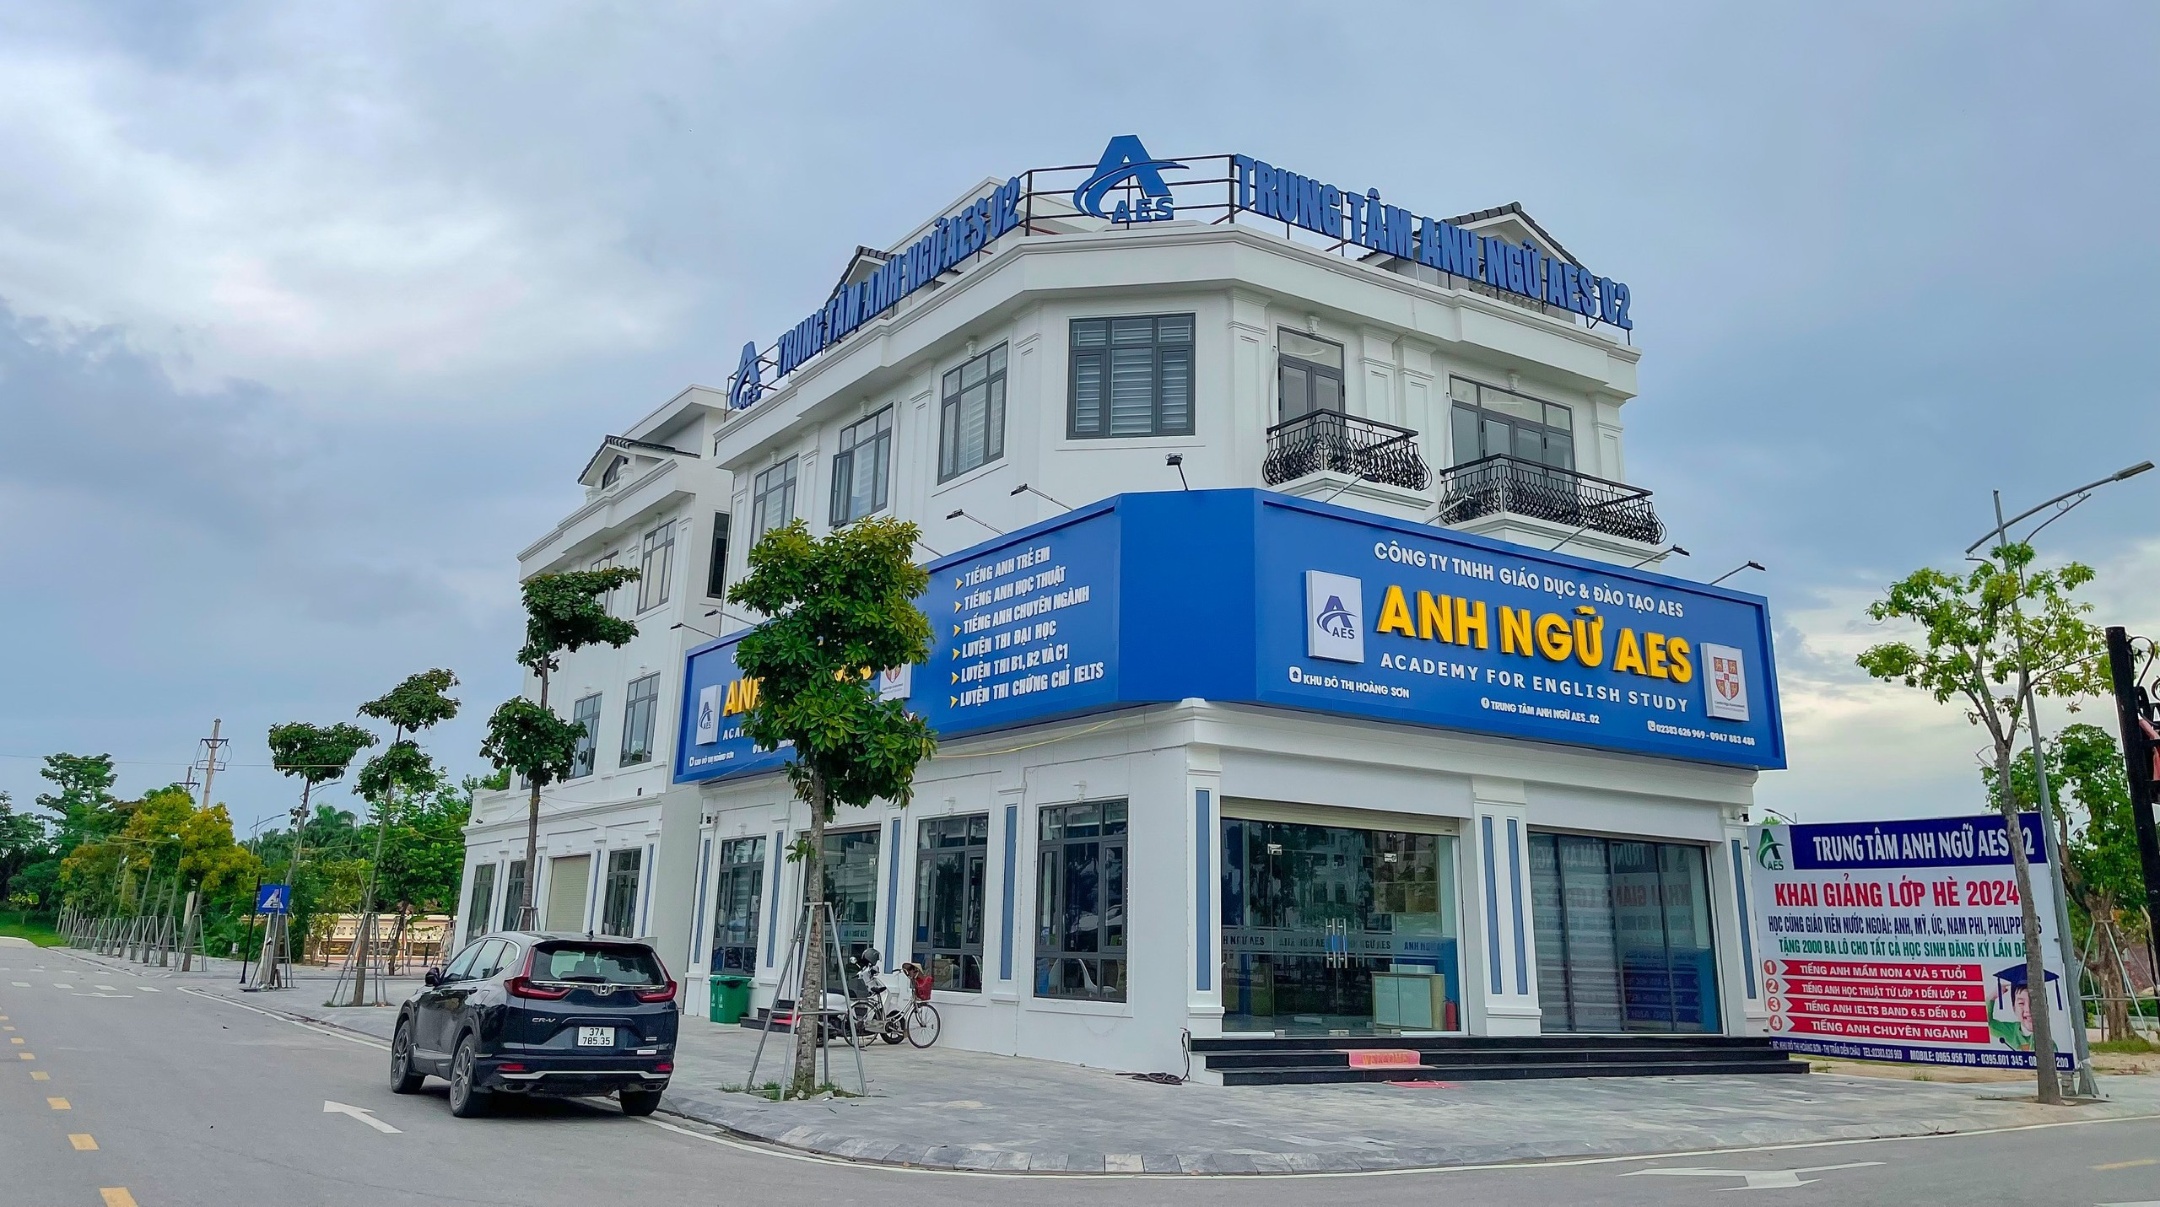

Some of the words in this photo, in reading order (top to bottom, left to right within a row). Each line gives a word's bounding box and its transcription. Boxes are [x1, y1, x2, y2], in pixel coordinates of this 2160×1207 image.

[1111, 198, 1175, 224] AES
[1235, 153, 1340, 239] TRUNG
[1347, 187, 1413, 260] TÂM
[1420, 217, 1480, 281] ANH
[1483, 239, 1543, 300] NGỮ
[1546, 257, 1597, 318] AES
[1600, 277, 1634, 331] 02
[777, 307, 826, 378] TRUNG
[826, 280, 864, 343] TÂM
[863, 253, 902, 320] ANH
[905, 216, 945, 295] NGỮ
[944, 199, 987, 269] AES
[990, 177, 1021, 239] 02
[738, 384, 762, 409] AES
[965, 564, 993, 587] TIẾNG
[995, 558, 1015, 578] ANH
[1017, 547, 1034, 570] TRẺ
[1035, 546, 1051, 564] EM
[1373, 540, 1427, 567] CÔNG
[1429, 555, 1449, 572] TY
[1452, 558, 1495, 582] TNHH
[1499, 564, 1540, 591] GIÁO
[1543, 576, 1576, 601] DỤC
[1579, 584, 1590, 599] &
[1593, 581, 1623, 605] ĐÀO
[1626, 592, 1656, 617] TẠO
[1657, 599, 1684, 618] AES
[964, 588, 992, 611] TIẾNG
[994, 583, 1014, 602] ANH
[1015, 576, 1034, 597] HỌC
[1036, 565, 1066, 590] THUẬT
[964, 611, 991, 634] TIẾNG
[992, 604, 1012, 627] ANH
[1014, 595, 1052, 619] CHUYÊN
[1053, 585, 1090, 610] NGÀNH
[962, 635, 992, 659] LUYỆN
[995, 632, 1011, 650] THI
[1014, 626, 1031, 646] ĐẠI
[1035, 620, 1057, 641] HỌC
[1331, 626, 1355, 640] AES
[1376, 585, 1489, 649] ANH
[1500, 606, 1604, 667] NGỮ
[1613, 627, 1693, 684] AES
[961, 660, 991, 683] LUYỆN
[994, 656, 1010, 676] THI
[1026, 651, 1040, 668] B2
[1042, 643, 1055, 665] VÀ
[1055, 643, 1069, 661] C1
[960, 685, 990, 707] LUYỆN
[993, 682, 1009, 700] THI
[1012, 673, 1048, 696] CHỨNG
[1051, 663, 1070, 688] CHỈ
[1074, 661, 1104, 683] IELTS
[1303, 674, 1322, 686] KHU
[1324, 676, 1338, 688] ĐÔ
[1340, 680, 1355, 693] THỊ
[1356, 681, 1388, 694] HOÀNG
[1391, 686, 1410, 698] SƠN
[1379, 652, 1478, 683] ACADEMY
[1486, 669, 1526, 690] FOR
[1533, 676, 1620, 703] ENGLISH
[1627, 689, 1689, 712] STUDY
[1490, 700, 1516, 713] TRUNG
[1518, 703, 1534, 716] TÂM
[1536, 708, 1552, 717] ANH
[1553, 709, 1570, 720] NGỮ
[1813, 835, 1864, 861] TRUNG
[1865, 826, 1899, 860] TÂM
[1902, 832, 1937, 859] ANH
[1938, 823, 1974, 858] NGỮ
[1978, 828, 2009, 857] AES
[1767, 860, 1784, 870] AES
[1774, 883, 1818, 907] KHAI
[1823, 872, 1883, 907] GIẢNG
[1888, 875, 1926, 907] LỚP
[1932, 876, 1960, 907] HÈ
[1966, 880, 2020, 906] 2024
[1768, 915, 1783, 936] HỌC
[1785, 912, 1804, 933] CÙNG
[1806, 913, 1822, 933] GIÁO
[1824, 913, 1842, 933] VIÊN
[1843, 912, 1864, 934] NƯỚC
[1865, 914, 1893, 934] NGOÀI:
[1894, 917, 1914, 936] ANH,
[1914, 914, 1931, 936] MỸ,
[1931, 913, 1946, 937] ÚC,
[1947, 917, 1967, 935] NAM
[1969, 917, 1986, 936] PHI,
[1778, 937, 1800, 956] TẶNG
[1802, 940, 1823, 954] 2000
[1824, 940, 1837, 954] BA
[1839, 938, 1849, 955] LÔ
[1850, 941, 1868, 955] CHO
[1870, 936, 1885, 956] TẤT
[1888, 935, 1901, 956] CẢ
[1903, 941, 1921, 960] HỌC
[1924, 941, 1946, 957] SINH
[1949, 938, 1975, 957] ĐĂNG
[1978, 938, 1990, 957] KÝ
[1993, 937, 2013, 958] LẦN
[1767, 961, 1773, 974] 1
[1799, 962, 1827, 975] TIẾNG
[1829, 966, 1850, 976] ANH
[1880, 968, 1902, 978] NON
[1904, 969, 1911, 978] 4
[1913, 967, 1930, 978] VÀ
[1931, 970, 1938, 978] 5
[1940, 964, 1967, 979] TUỔI
[1768, 980, 1777, 993] 2
[1801, 981, 1823, 994] TIẾNG
[1824, 985, 1840, 995] ANH
[1841, 987, 1857, 998] HỌC
[1859, 985, 1884, 999] THUẬT
[1898, 986, 1913, 997] LỚP
[1914, 989, 1919, 998] 1
[1940, 987, 1956, 999] LỚP
[1957, 990, 1967, 999] 12
[1770, 999, 1778, 1011] 3
[1804, 1000, 1830, 1013] TIẾNG
[1832, 1004, 1852, 1013] ANH
[1854, 1006, 1879, 1015] IELTS
[1881, 1006, 1909, 1017] BAND
[1910, 1008, 1925, 1017] 6.5
[1950, 1009, 1966, 1019] 8.0
[589, 1028, 604, 1037] 37A
[1772, 1016, 1781, 1029] 4
[1811, 1019, 1843, 1032] TIẾNG
[1846, 1024, 1870, 1034] ANH
[1873, 1024, 1921, 1037] CHUYÊN
[1924, 1027, 1968, 1039] NGÀNH
[582, 1037, 611, 1046] 785.35
[2056, 1057, 2069, 1068] 200
